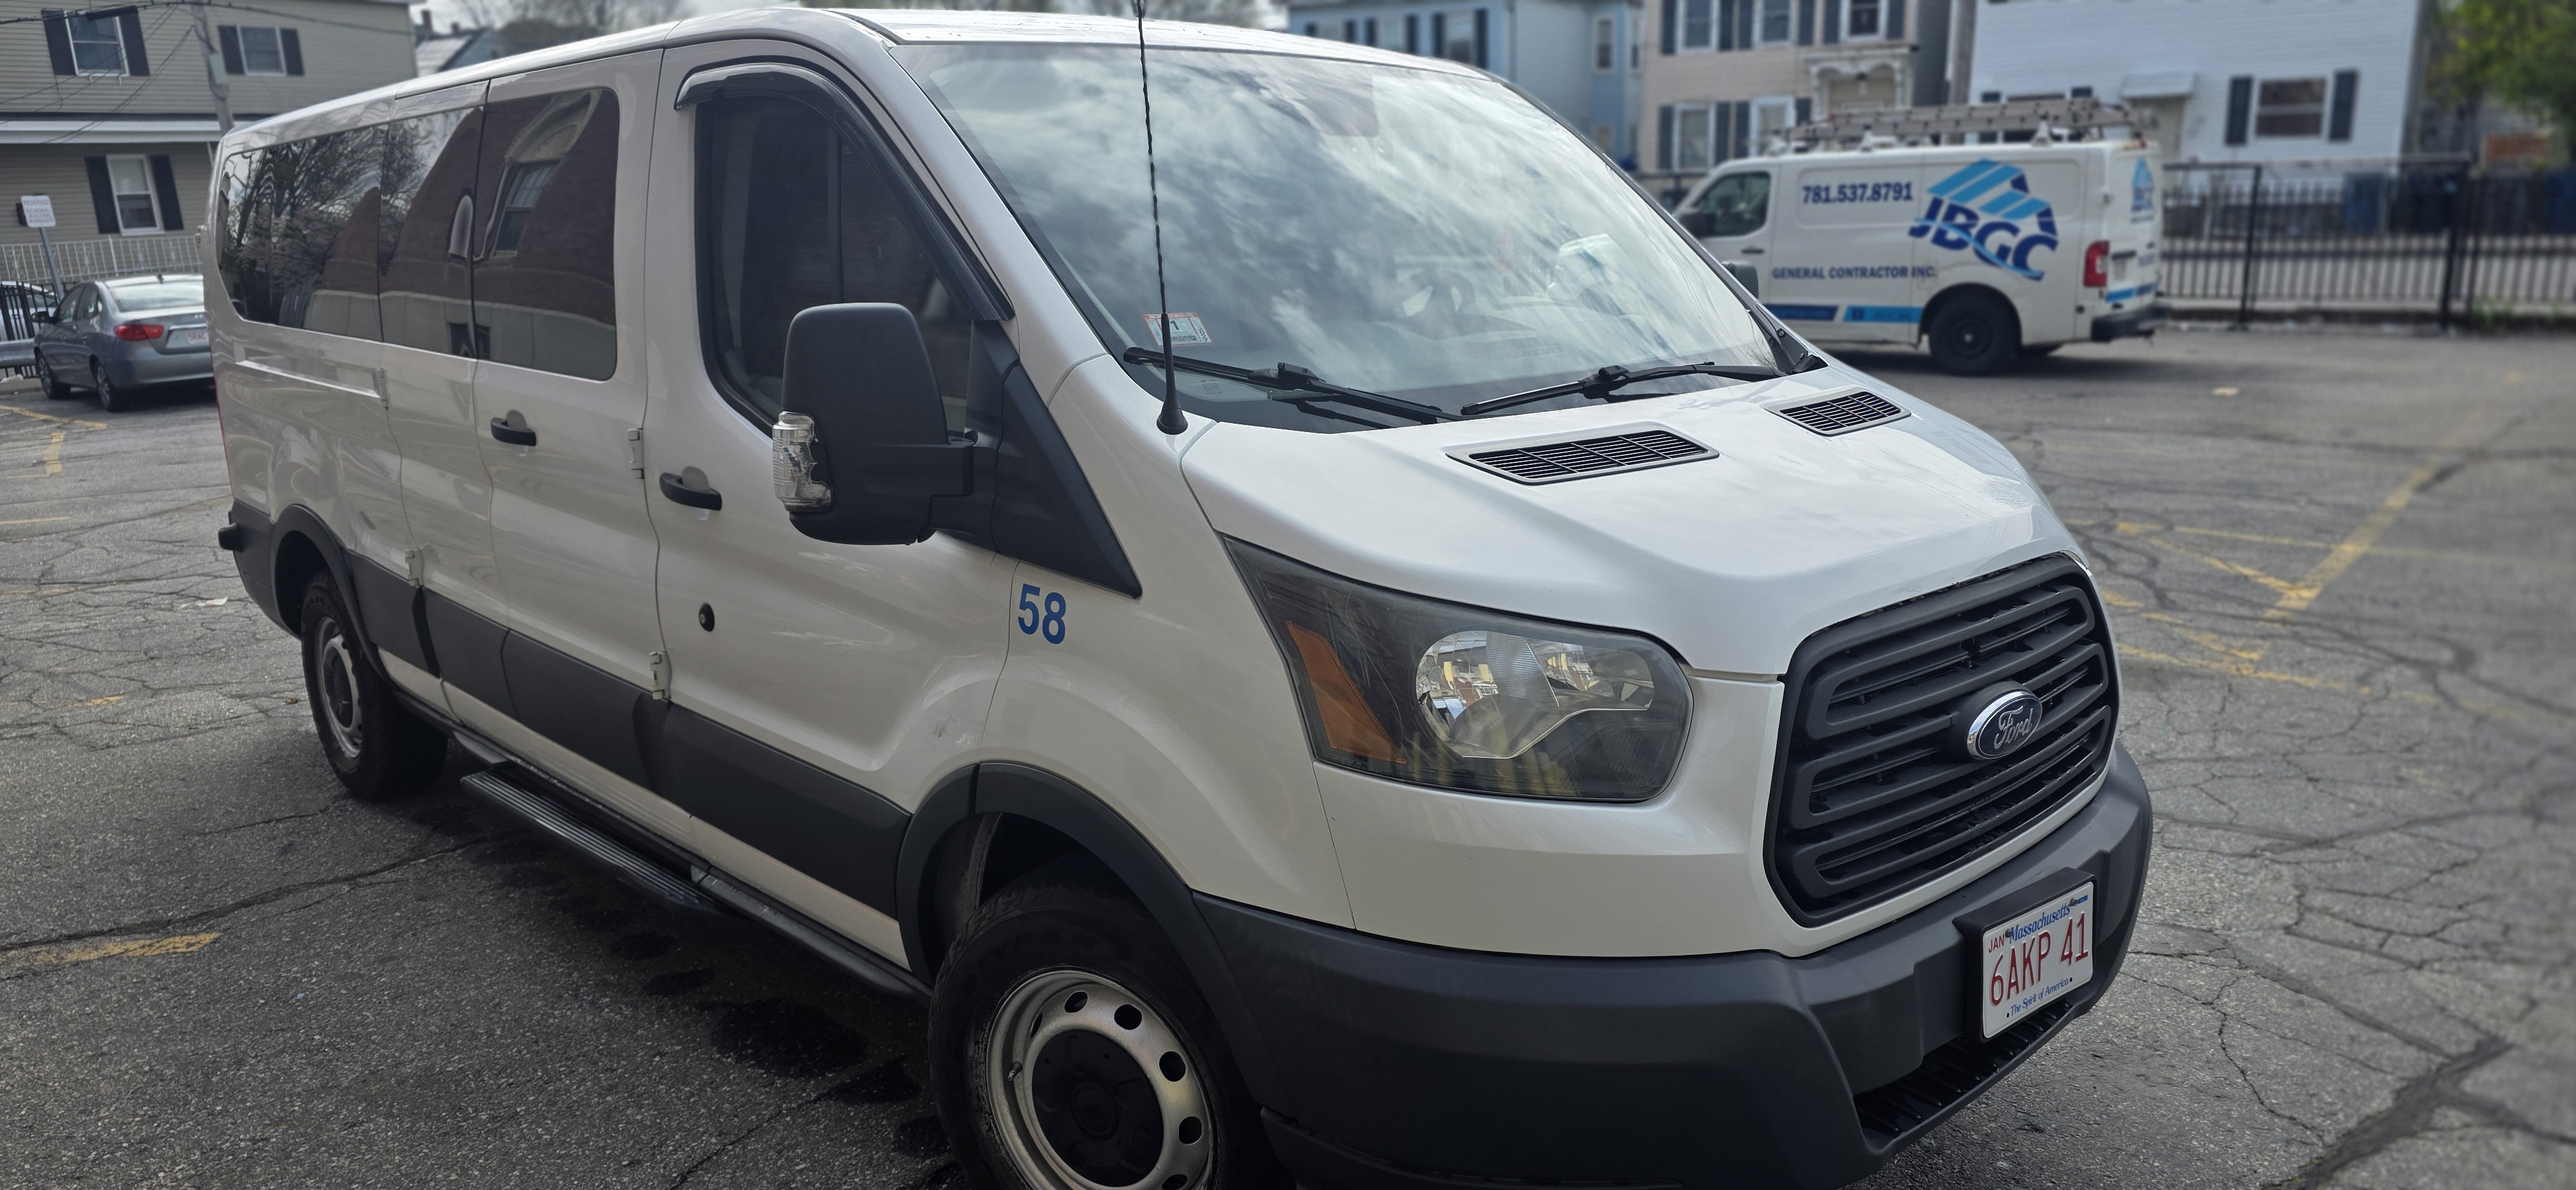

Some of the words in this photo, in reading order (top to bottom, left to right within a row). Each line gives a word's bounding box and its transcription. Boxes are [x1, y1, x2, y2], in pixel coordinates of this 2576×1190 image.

[1802, 182, 1913, 204] 781.537.8791
[1908, 196, 2059, 281] JBGC
[1772, 267, 1826, 279] GENERAL
[1828, 266, 1909, 279] CONTRACTOR
[1018, 583, 1067, 645] 58
[1994, 705, 2034, 750] Ford
[1988, 933, 2005, 954] JAN
[2009, 902, 2071, 944] Massachusetts
[1989, 930, 2051, 1006] 6AKP
[2061, 911, 2088, 967] 41
[2010, 1003, 2022, 1016] The
[2023, 993, 2037, 1010] Spirit
[2038, 990, 2045, 1001] of
[2045, 979, 2069, 995] America
